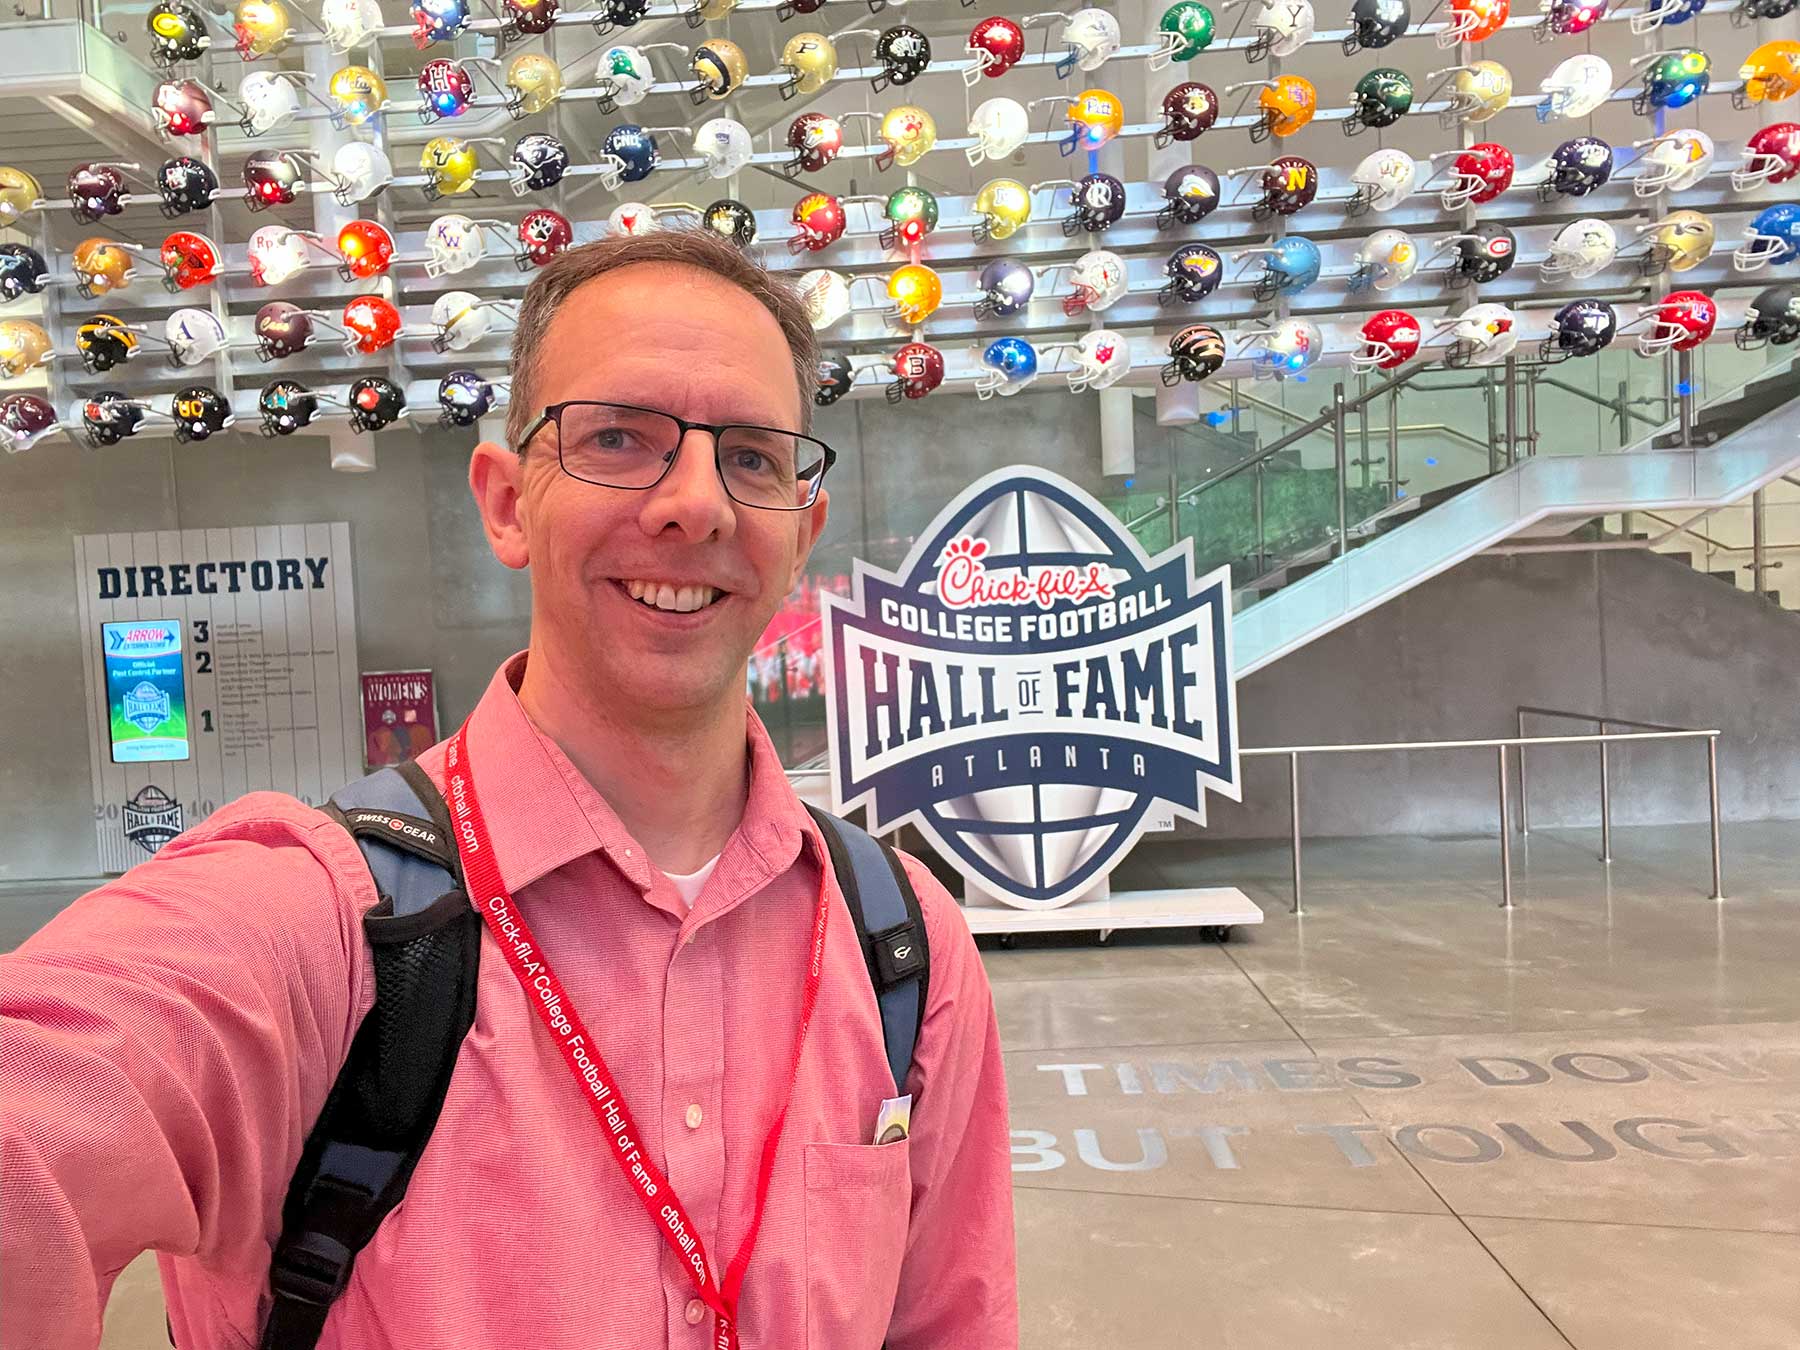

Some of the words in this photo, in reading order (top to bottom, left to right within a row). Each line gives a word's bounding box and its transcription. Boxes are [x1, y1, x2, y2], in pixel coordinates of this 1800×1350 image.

[1287, 6, 1304, 27] Y
[797, 42, 818, 53] P
[430, 66, 450, 92] H
[1480, 70, 1505, 93] BU
[1286, 169, 1308, 190] N
[438, 225, 461, 248] KW
[908, 356, 928, 377] B
[97, 557, 329, 600] DIRECTORY
[940, 539, 1111, 606] Chick-fil-A
[880, 597, 1013, 643] COLLEGE
[1019, 583, 1172, 643] FOOTBALL
[126, 628, 165, 642] ARROW
[193, 620, 209, 643] 3
[195, 652, 212, 674] 2
[859, 644, 1009, 761] HALL
[1017, 677, 1042, 709] OF
[1053, 622, 1204, 742] FAME
[201, 710, 215, 732] 1
[931, 745, 1146, 788] ATLANTA
[127, 812, 148, 831] HALL
[157, 810, 180, 829] FAME
[451, 774, 480, 854] cfbhall.com
[1158, 821, 1173, 829] TM
[355, 813, 390, 825] SWISS
[402, 824, 436, 844] GEAR
[1036, 1055, 1425, 1096] TIMES
[534, 975, 572, 1036] College
[567, 1034, 611, 1101] Football
[602, 1098, 628, 1135] Hall
[618, 1134, 634, 1153] of
[626, 1149, 658, 1197] Fame
[660, 1204, 707, 1287] cfbhall.com
[1011, 1128, 1251, 1173] BUT
